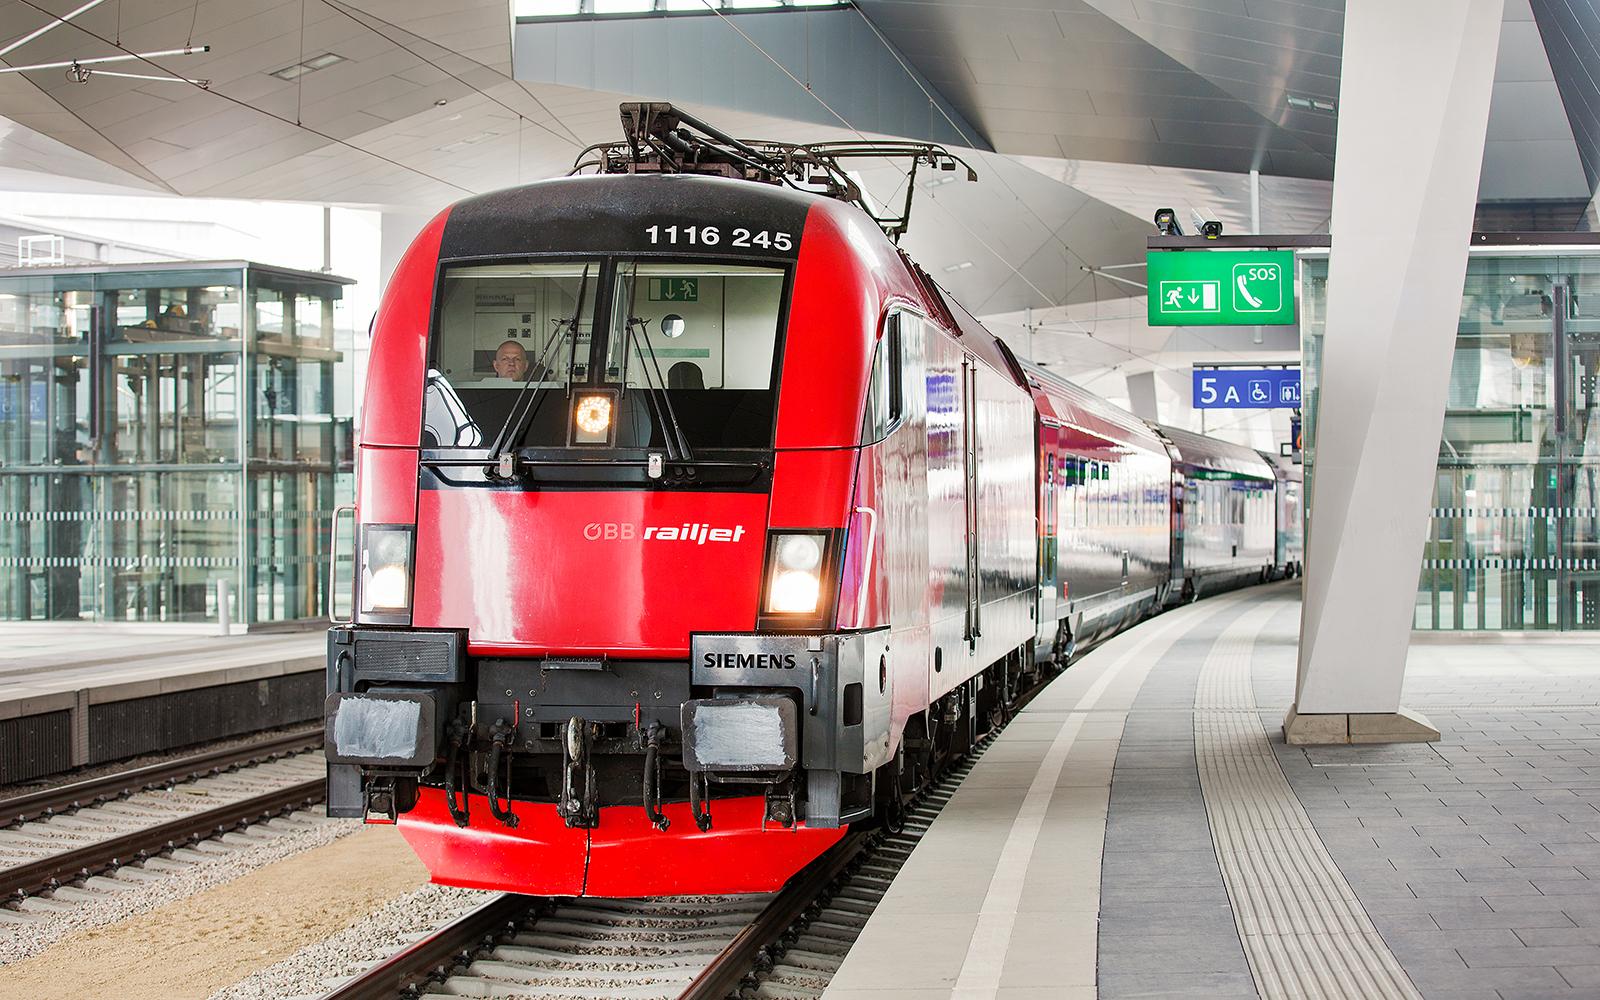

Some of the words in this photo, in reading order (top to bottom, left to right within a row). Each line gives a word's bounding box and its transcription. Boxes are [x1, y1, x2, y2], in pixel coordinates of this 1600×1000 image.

[645, 225, 720, 246] 1116
[731, 228, 793, 251] 245
[1249, 268, 1276, 281] SOS
[1201, 378, 1217, 404] 5
[1224, 386, 1240, 403] A
[583, 523, 635, 541] ÖBB
[643, 523, 746, 545] railjet
[703, 653, 796, 669] SIEMENS
